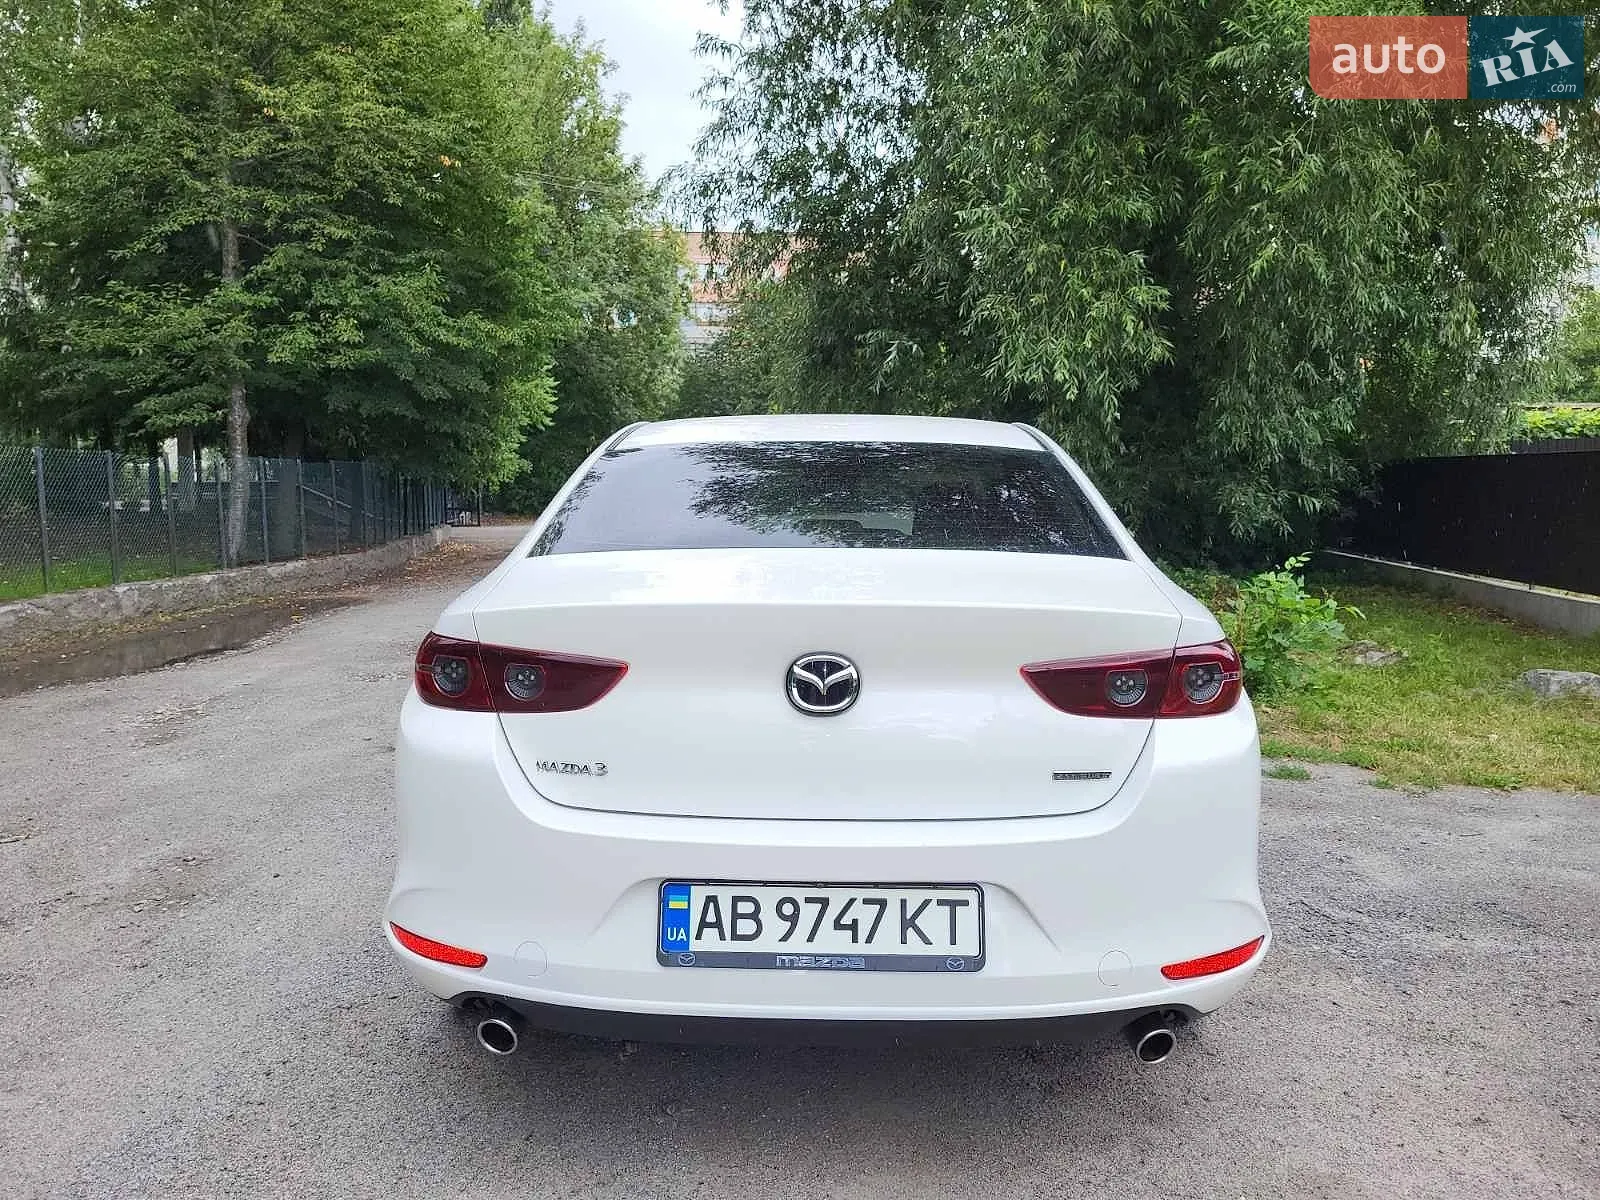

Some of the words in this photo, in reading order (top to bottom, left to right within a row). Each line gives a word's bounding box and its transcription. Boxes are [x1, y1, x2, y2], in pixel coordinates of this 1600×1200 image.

[536, 760, 592, 776] MAZDA
[594, 761, 608, 777] 3
[695, 895, 763, 942] AB
[775, 896, 888, 944] 9747
[900, 898, 969, 946] KT
[666, 927, 687, 942] UA
